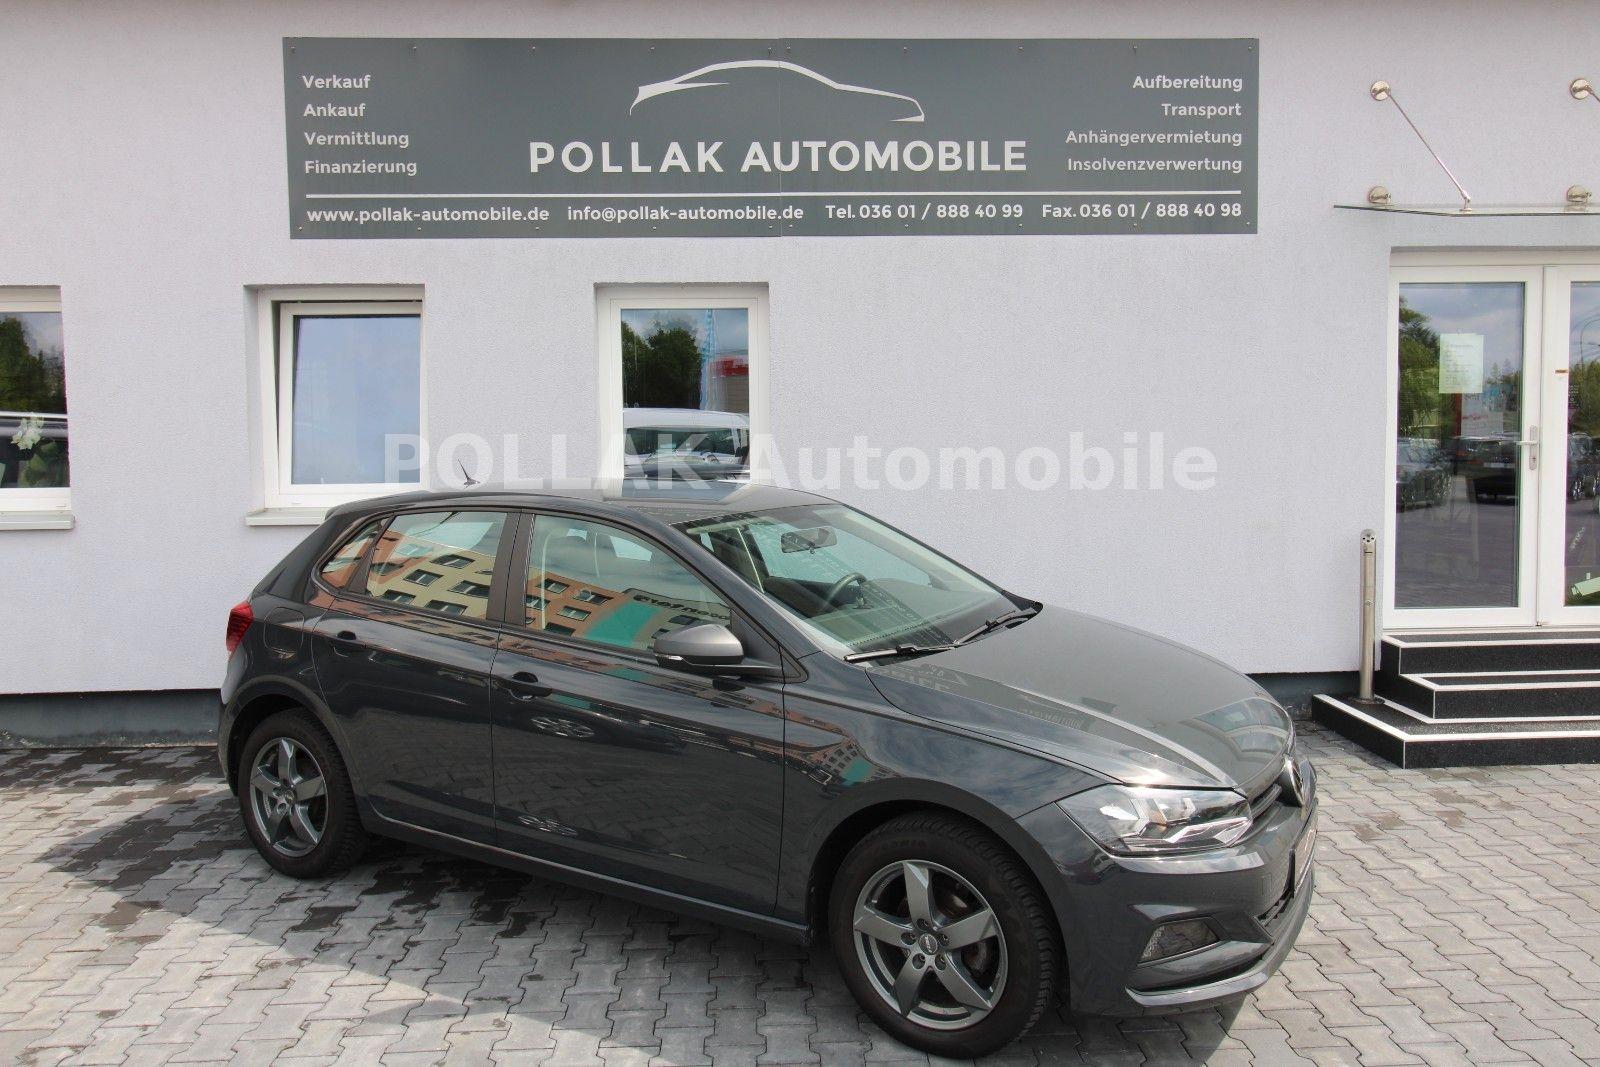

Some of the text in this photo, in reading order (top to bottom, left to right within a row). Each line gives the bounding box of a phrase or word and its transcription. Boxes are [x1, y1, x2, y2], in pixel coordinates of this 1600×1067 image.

[302, 75, 371, 88] Verkauf
[1133, 75, 1242, 92] Aufbereitung
[304, 103, 365, 116] Ankauf
[1161, 103, 1241, 119] Transport
[304, 132, 409, 148] Vermittlung
[1065, 129, 1242, 146] Anhängervermietung
[530, 140, 1026, 172] POLLAK AUTOMOBILE
[305, 160, 417, 177] Finanzierung
[1068, 158, 1242, 175] Insolvenzverwertung
[307, 207, 549, 224] www.pollak-automobile.de
[568, 205, 803, 223] info@pollak-automobile.de
[898, 205, 915, 218] 01
[937, 205, 969, 218] 888
[975, 204, 996, 217] 40
[1002, 204, 1023, 217] 99
[1118, 203, 1134, 217] 01
[1156, 204, 1188, 217] 888
[1194, 203, 1215, 216] 40
[1221, 203, 1241, 216] 98
